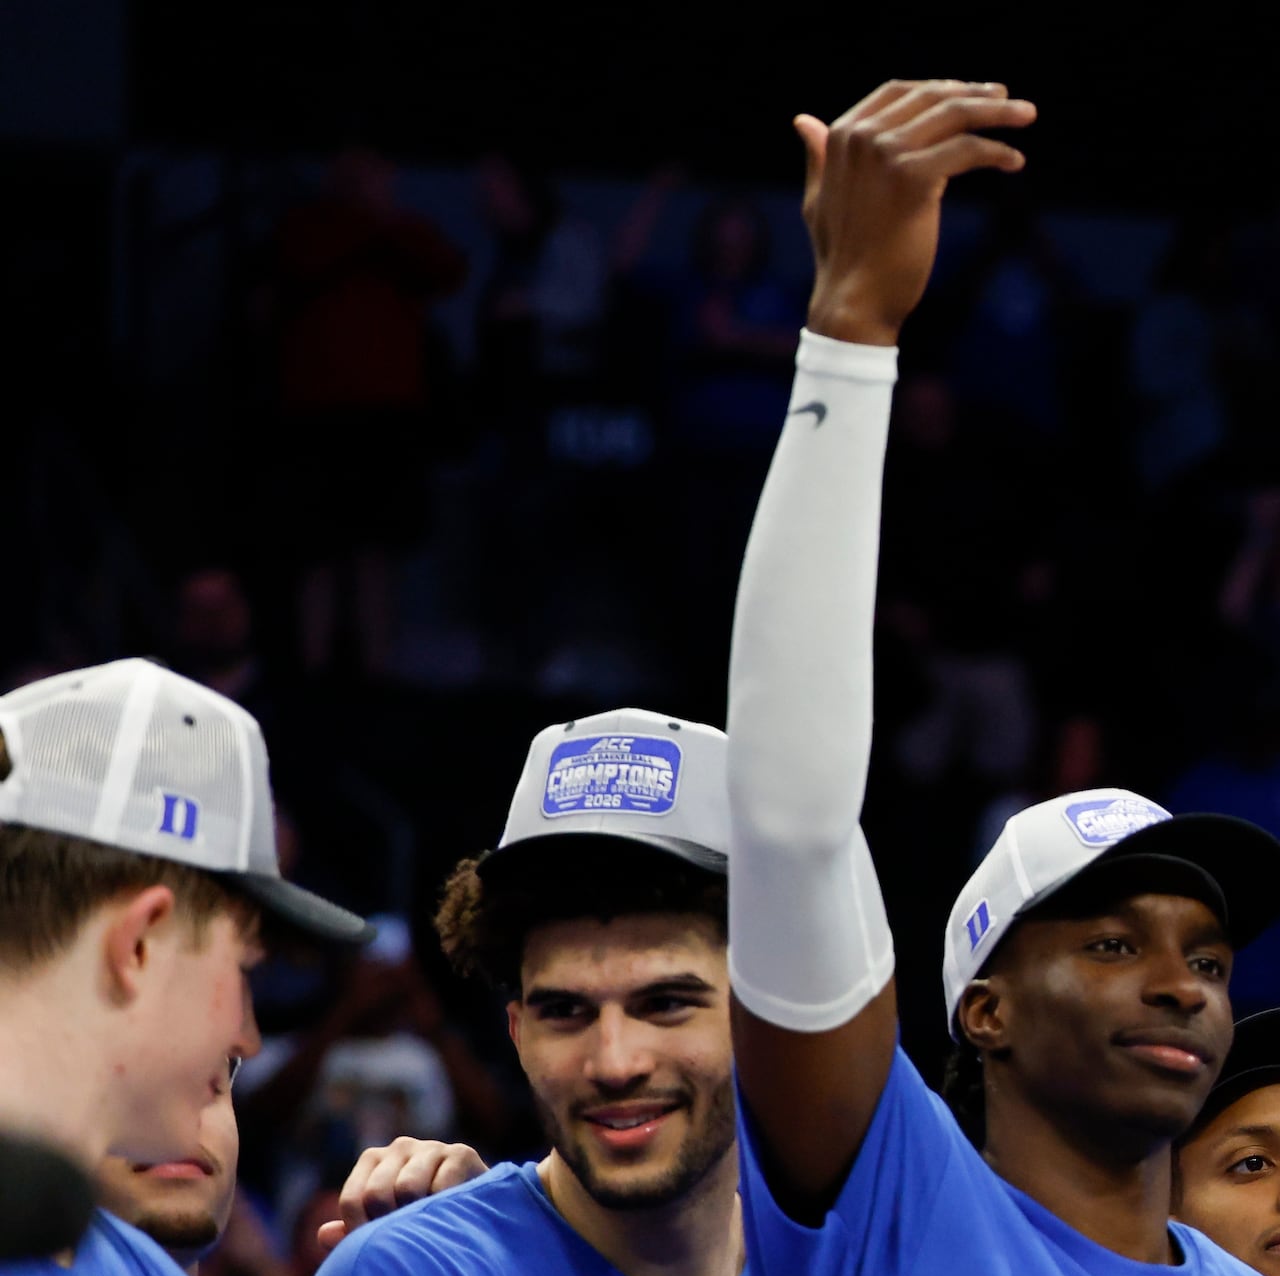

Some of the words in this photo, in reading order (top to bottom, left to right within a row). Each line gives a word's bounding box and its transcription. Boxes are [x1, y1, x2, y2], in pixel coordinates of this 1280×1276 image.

[588, 738, 635, 753] ACC
[548, 763, 674, 793] CHAMPIONS
[584, 794, 622, 807] 2026
